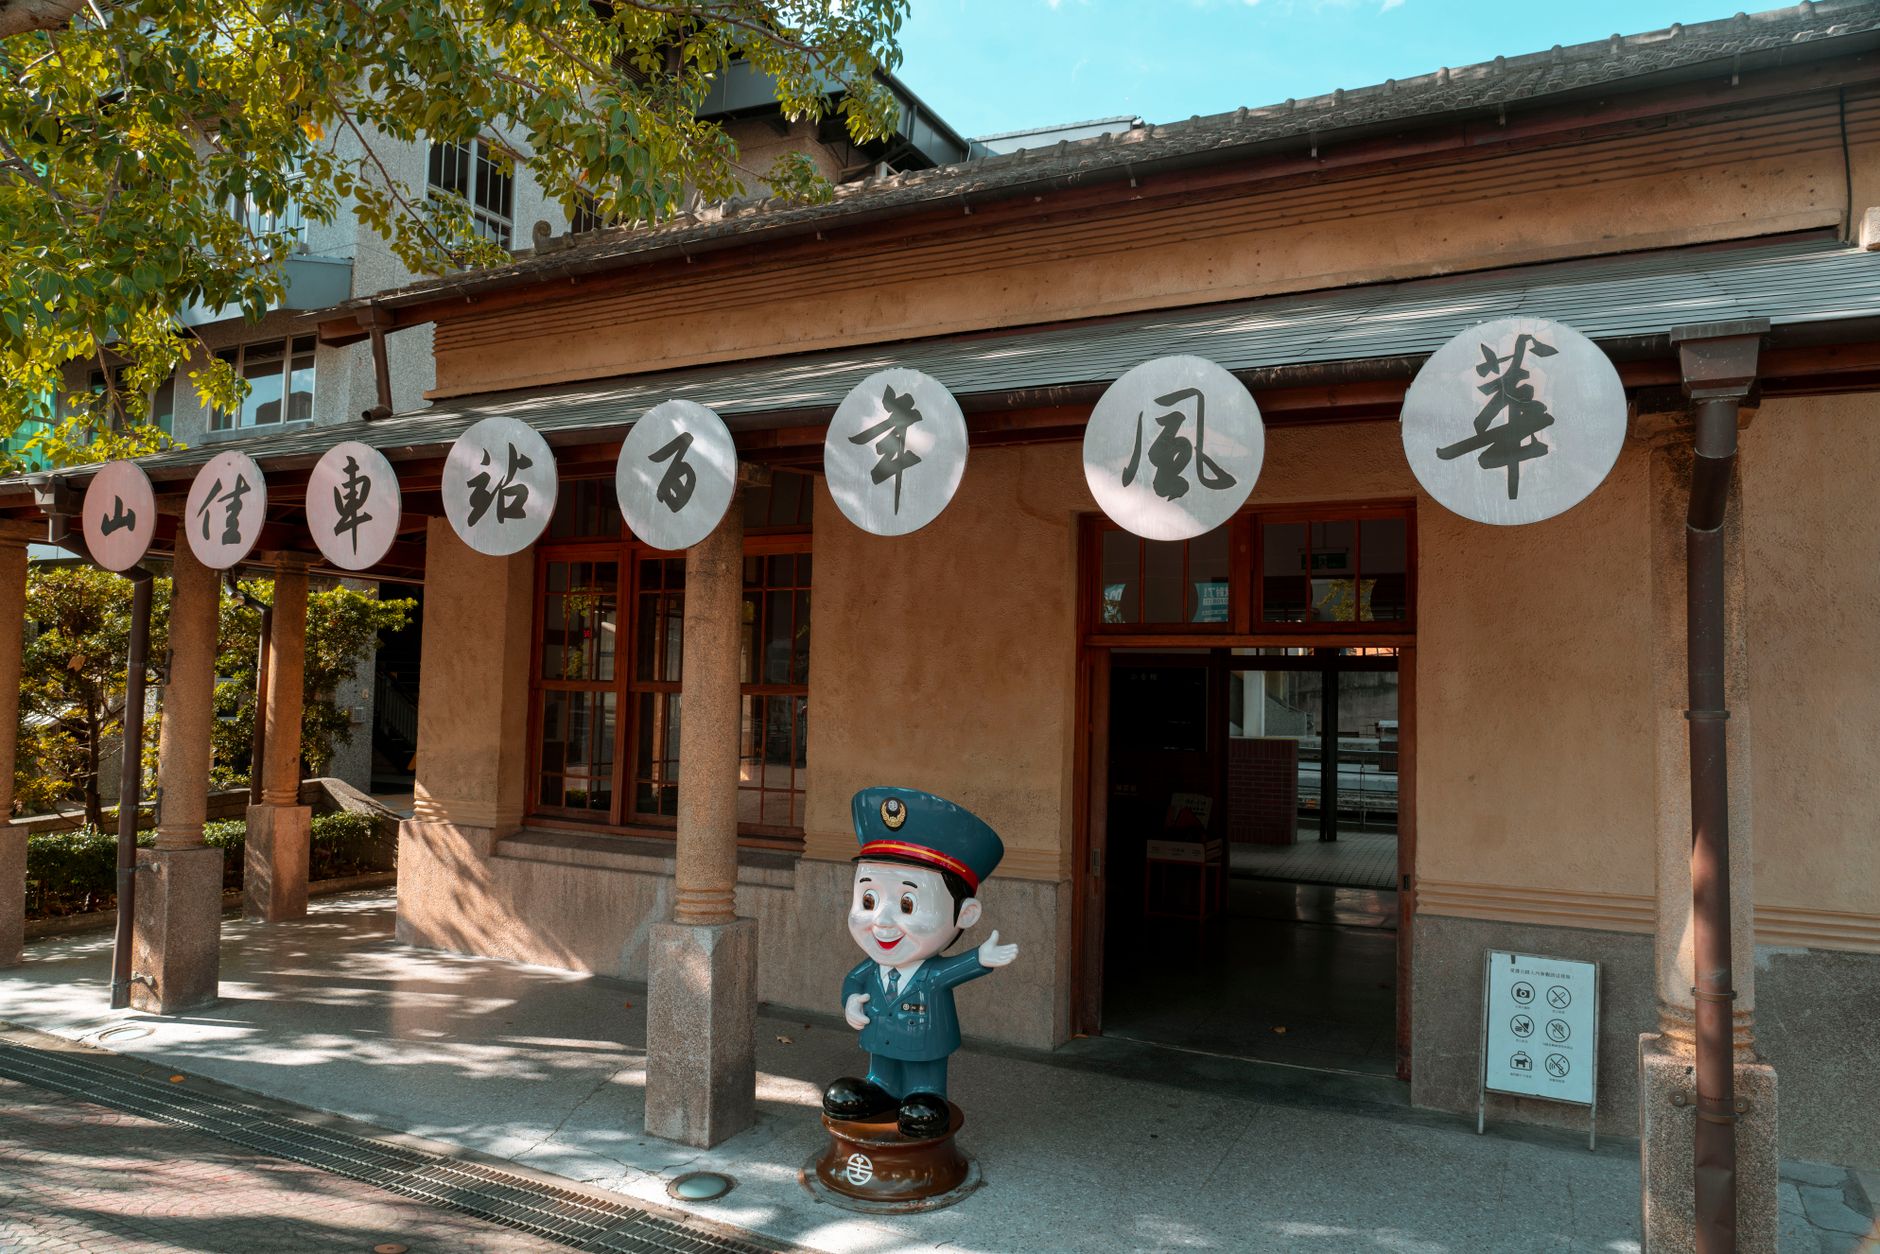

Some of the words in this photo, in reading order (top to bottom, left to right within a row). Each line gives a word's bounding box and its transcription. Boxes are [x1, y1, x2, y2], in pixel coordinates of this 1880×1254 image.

[101, 495, 136, 536] 山
[198, 474, 251, 544] 佳
[334, 456, 372, 555] 車
[467, 443, 533, 527] 站
[648, 432, 696, 513] 百
[848, 384, 922, 515] 年
[1122, 388, 1236, 501] 風
[1436, 335, 1558, 499] 華
